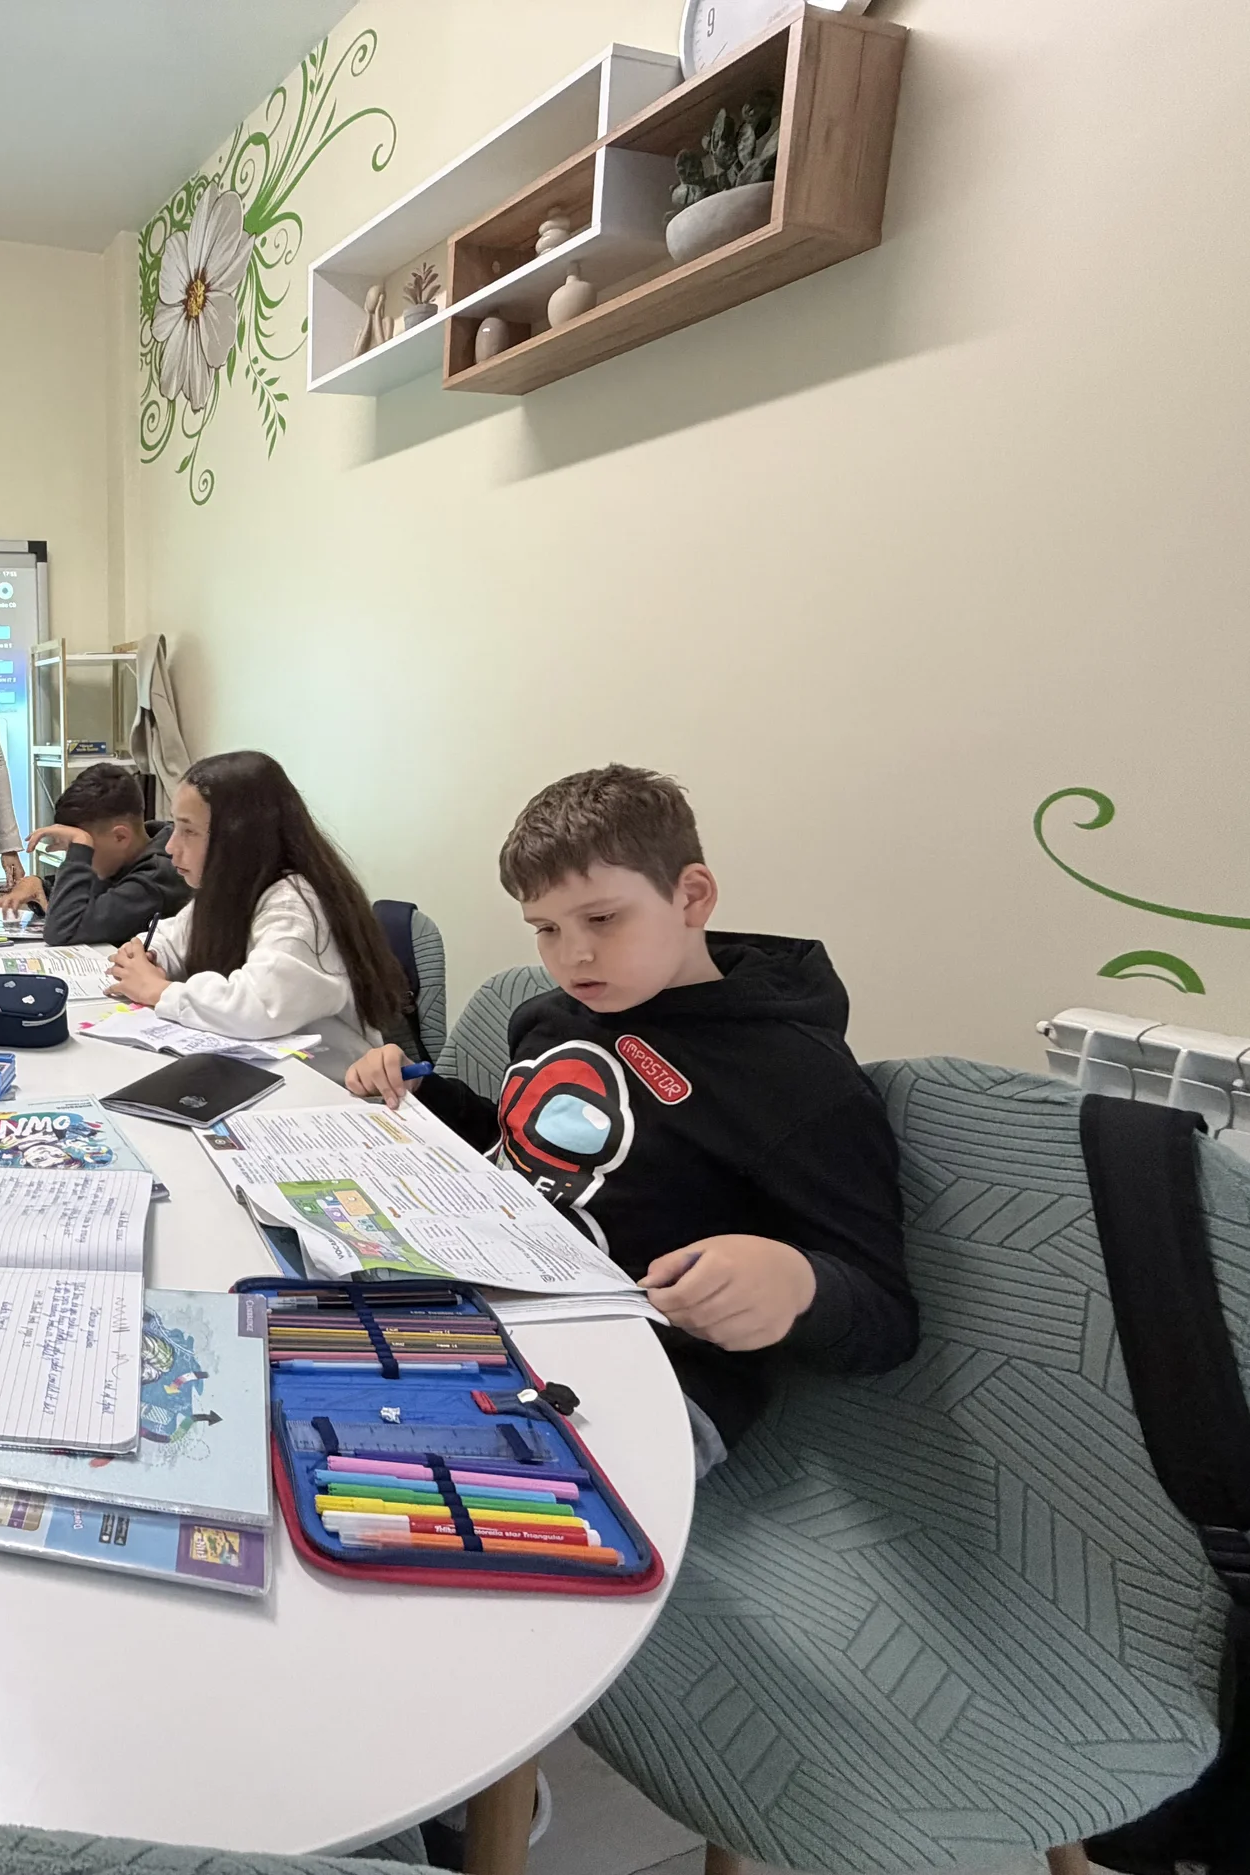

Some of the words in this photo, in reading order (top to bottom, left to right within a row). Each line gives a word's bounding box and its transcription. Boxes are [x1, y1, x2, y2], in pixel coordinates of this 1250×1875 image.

[706, 7, 715, 38] 9
[622, 1040, 682, 1098] IMPOSTOR
[244, 1299, 254, 1332] CAMBRIDGE
[474, 1528, 504, 1537] olorella
